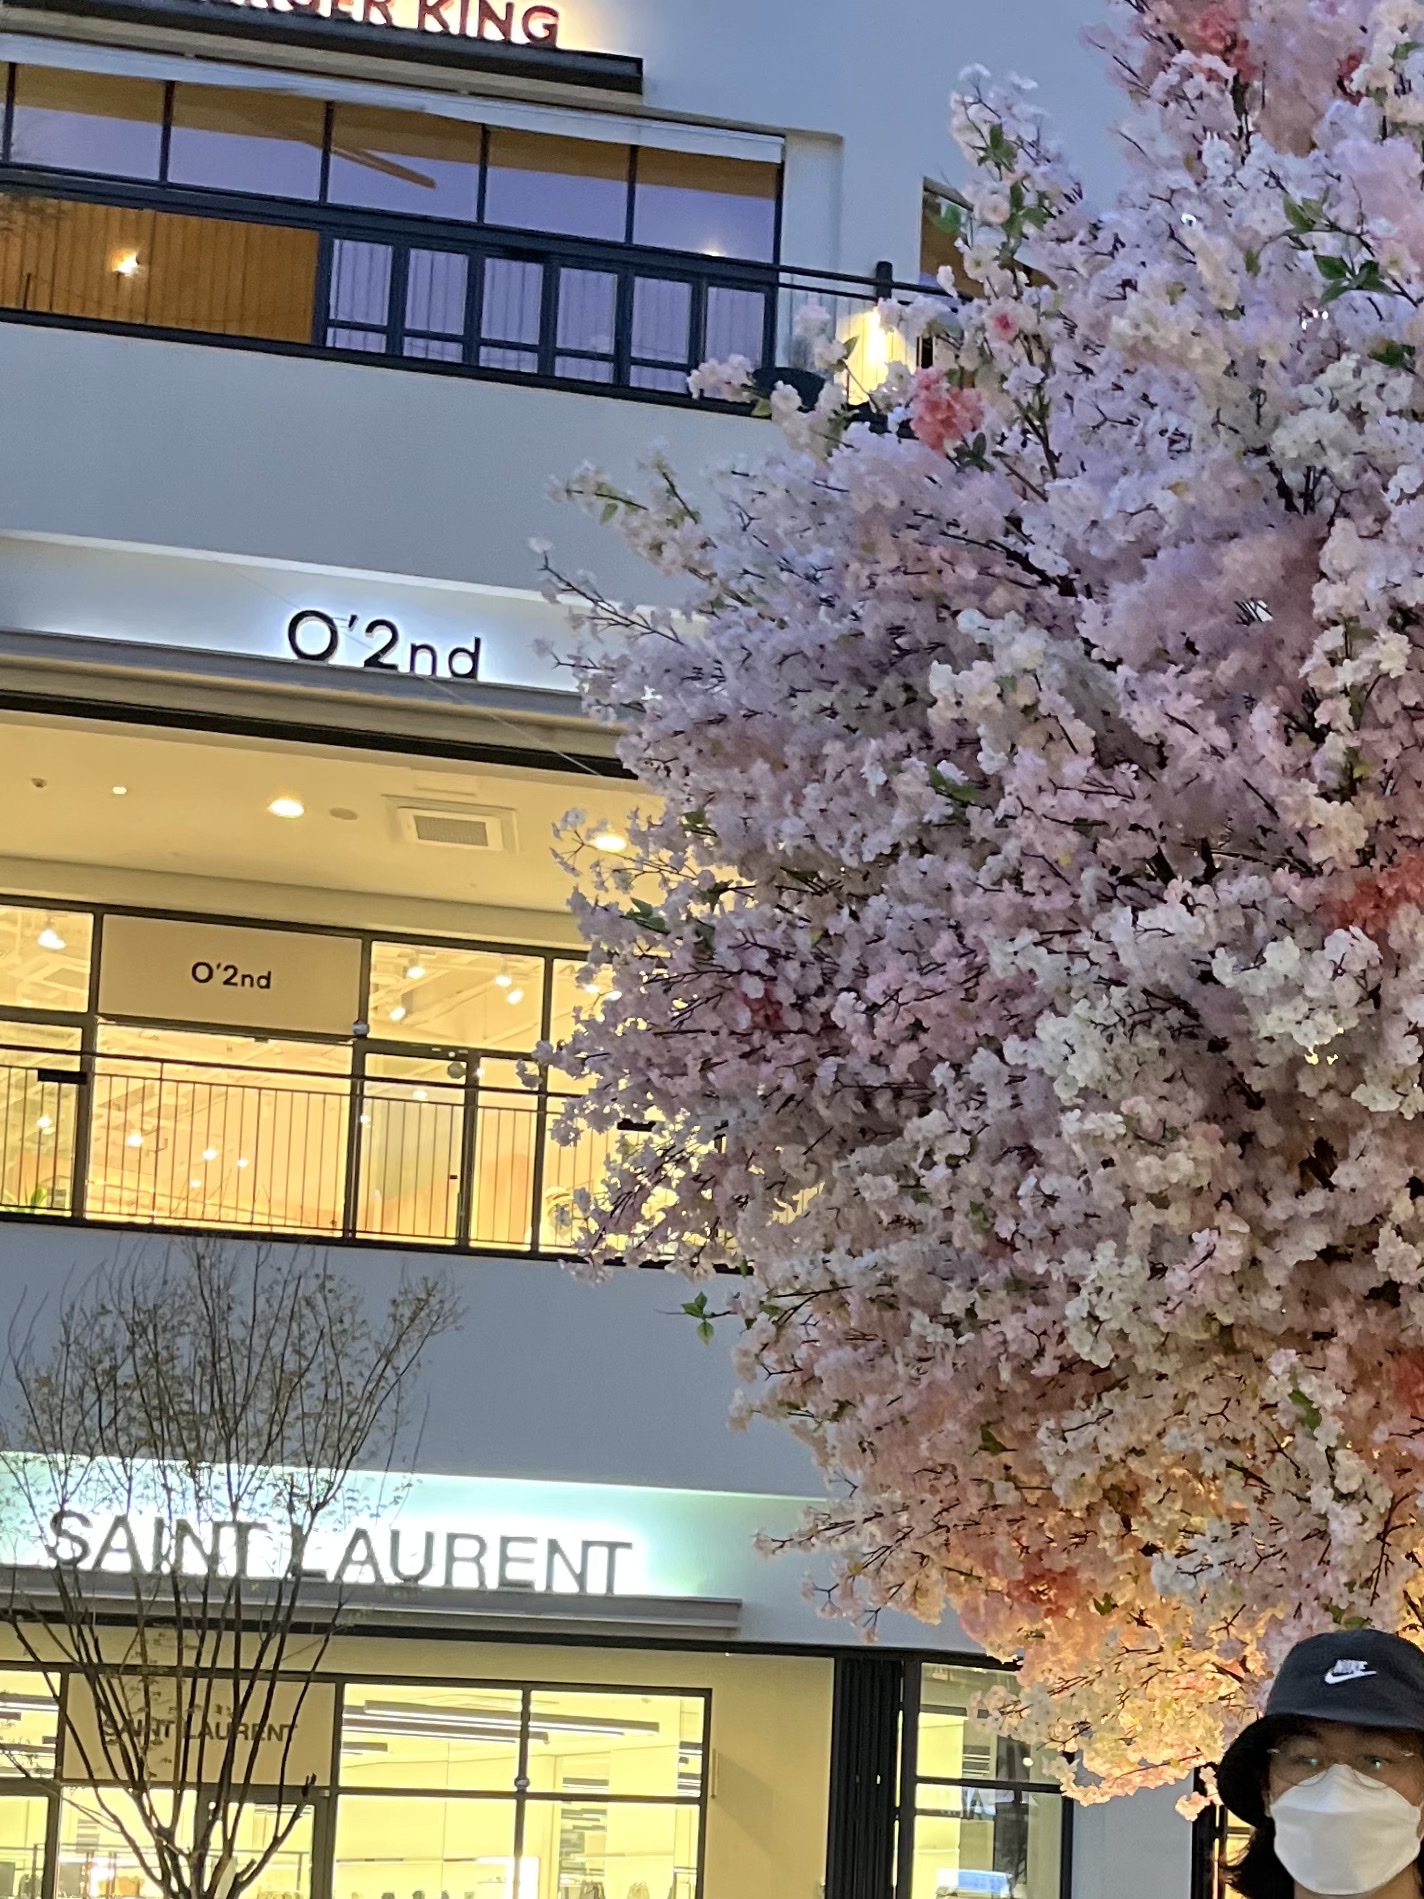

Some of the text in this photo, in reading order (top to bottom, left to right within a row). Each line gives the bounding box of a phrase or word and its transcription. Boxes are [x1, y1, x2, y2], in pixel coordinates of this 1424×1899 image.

[418, 0, 560, 48] KING
[288, 609, 482, 681] O'2nd
[191, 961, 272, 989] O'2nd
[48, 1510, 634, 1596] SAINT LAURENT
